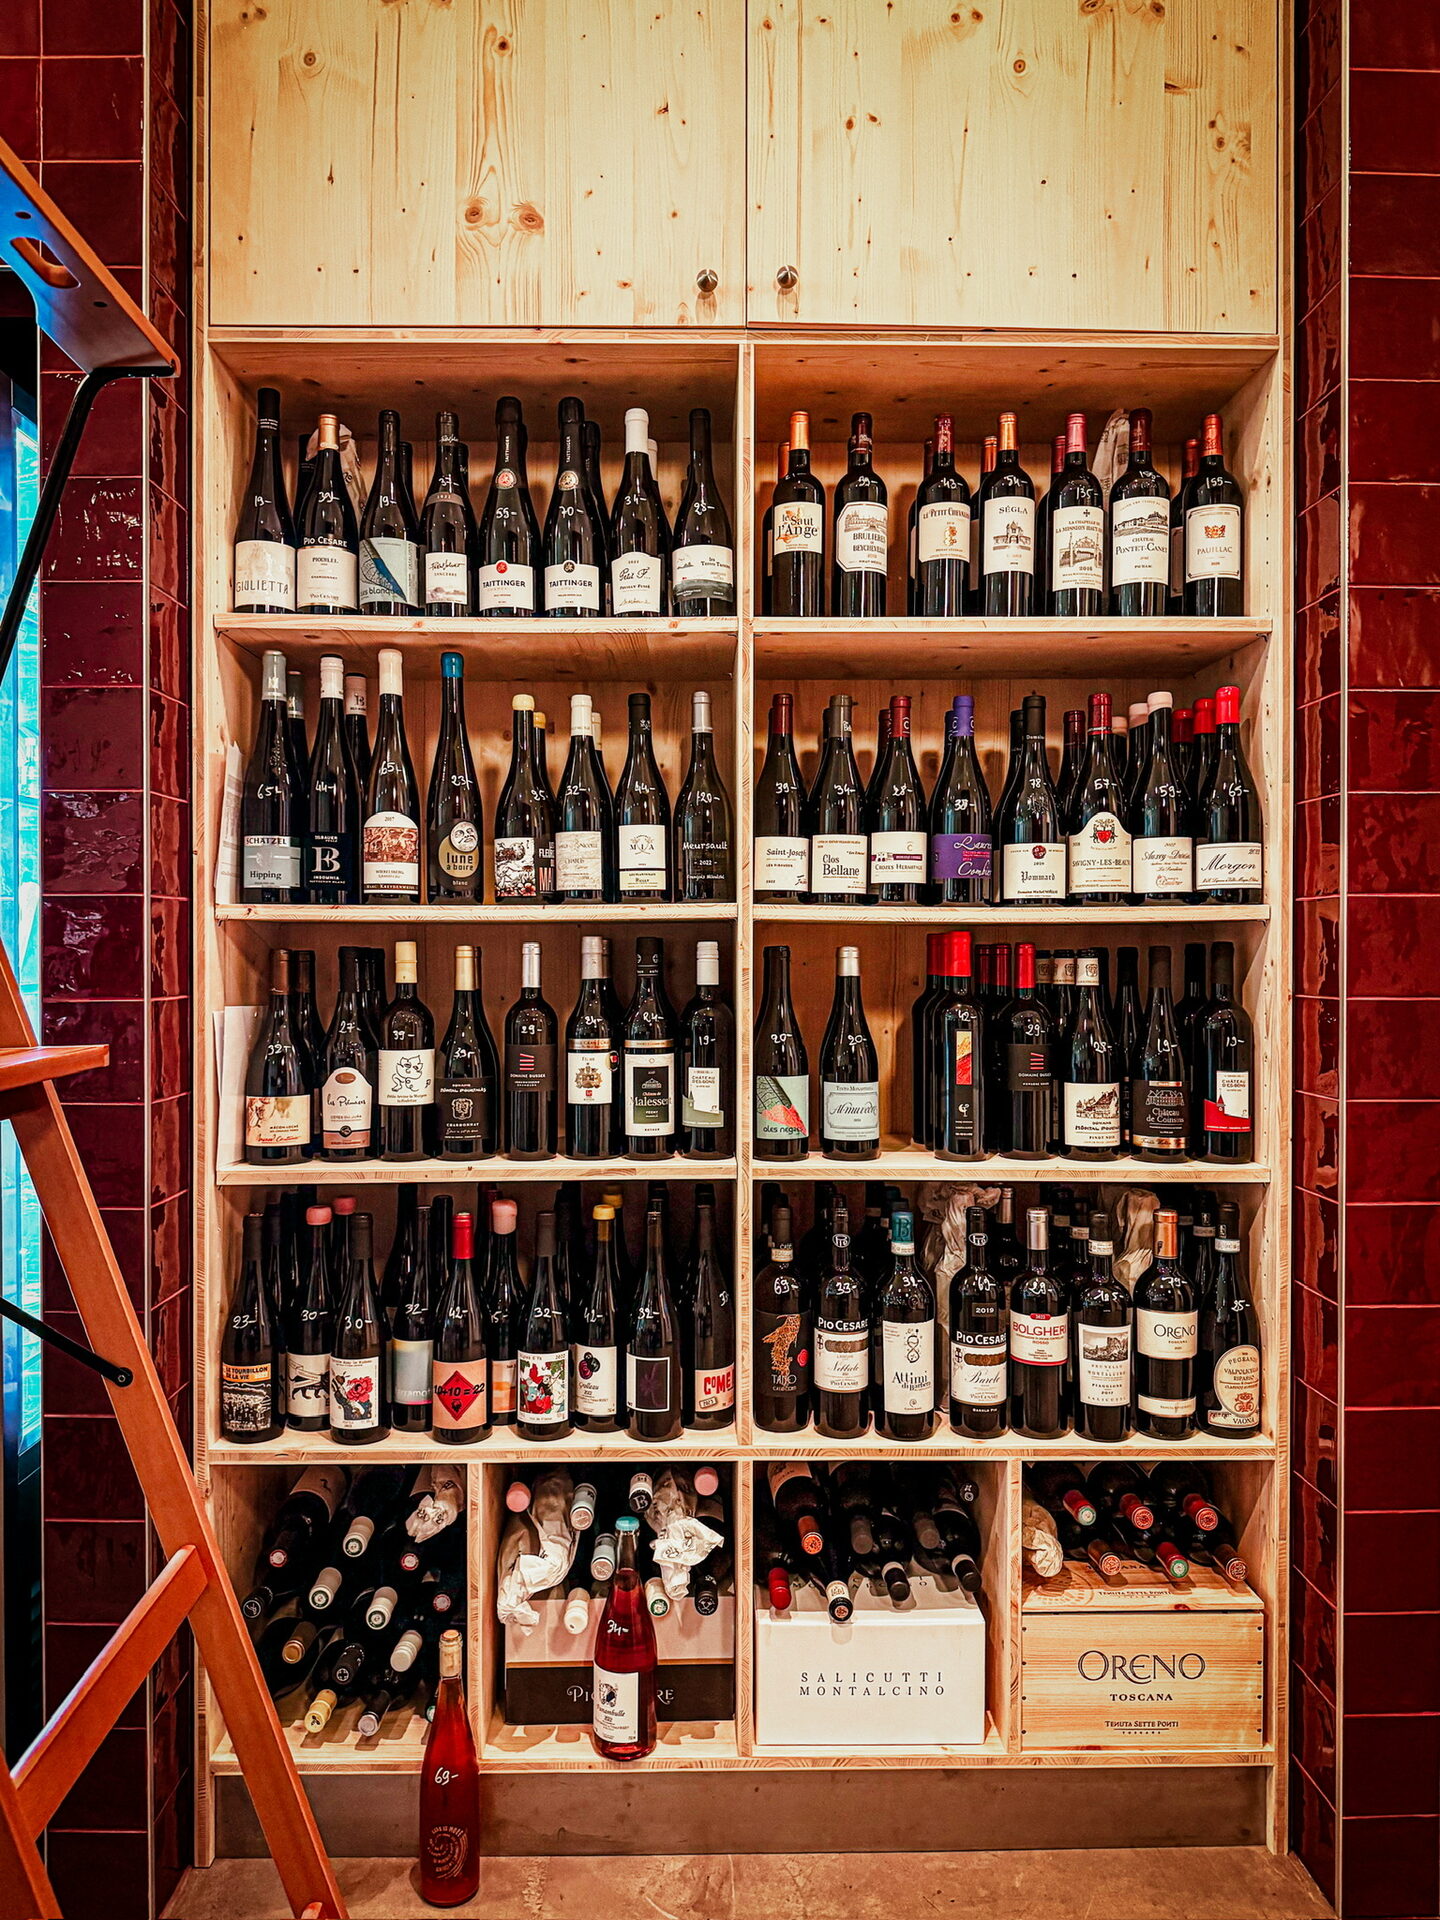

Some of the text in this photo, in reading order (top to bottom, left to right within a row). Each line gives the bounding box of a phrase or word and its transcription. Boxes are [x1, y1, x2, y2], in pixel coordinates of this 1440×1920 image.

[999, 505, 1028, 514] SÉGLA
[791, 515, 813, 526] Saut
[304, 536, 347, 547] PIO CESARE
[1197, 547, 1232, 555] PAUILLAC
[236, 580, 288, 594] GIULIETTA
[683, 842, 727, 850] Meursault
[447, 852, 473, 864] lune
[823, 855, 839, 864] Clos
[1201, 854, 1256, 874] Morgon
[250, 871, 282, 880] Hipping
[823, 864, 859, 876] Bellane
[1021, 871, 1055, 883] Pommard
[818, 1317, 868, 1331] PIO CESARE
[1154, 1324, 1196, 1338] ORENO
[956, 1331, 1007, 1345] PIO CESARE
[892, 1371, 928, 1384] Attimi
[968, 1371, 1000, 1384] Barolo
[472, 1383, 484, 1394] 22
[1077, 1650, 1206, 1685] ORENO
[801, 1672, 943, 1682] SALICUTTI
[800, 1687, 945, 1696] MONTALCINO
